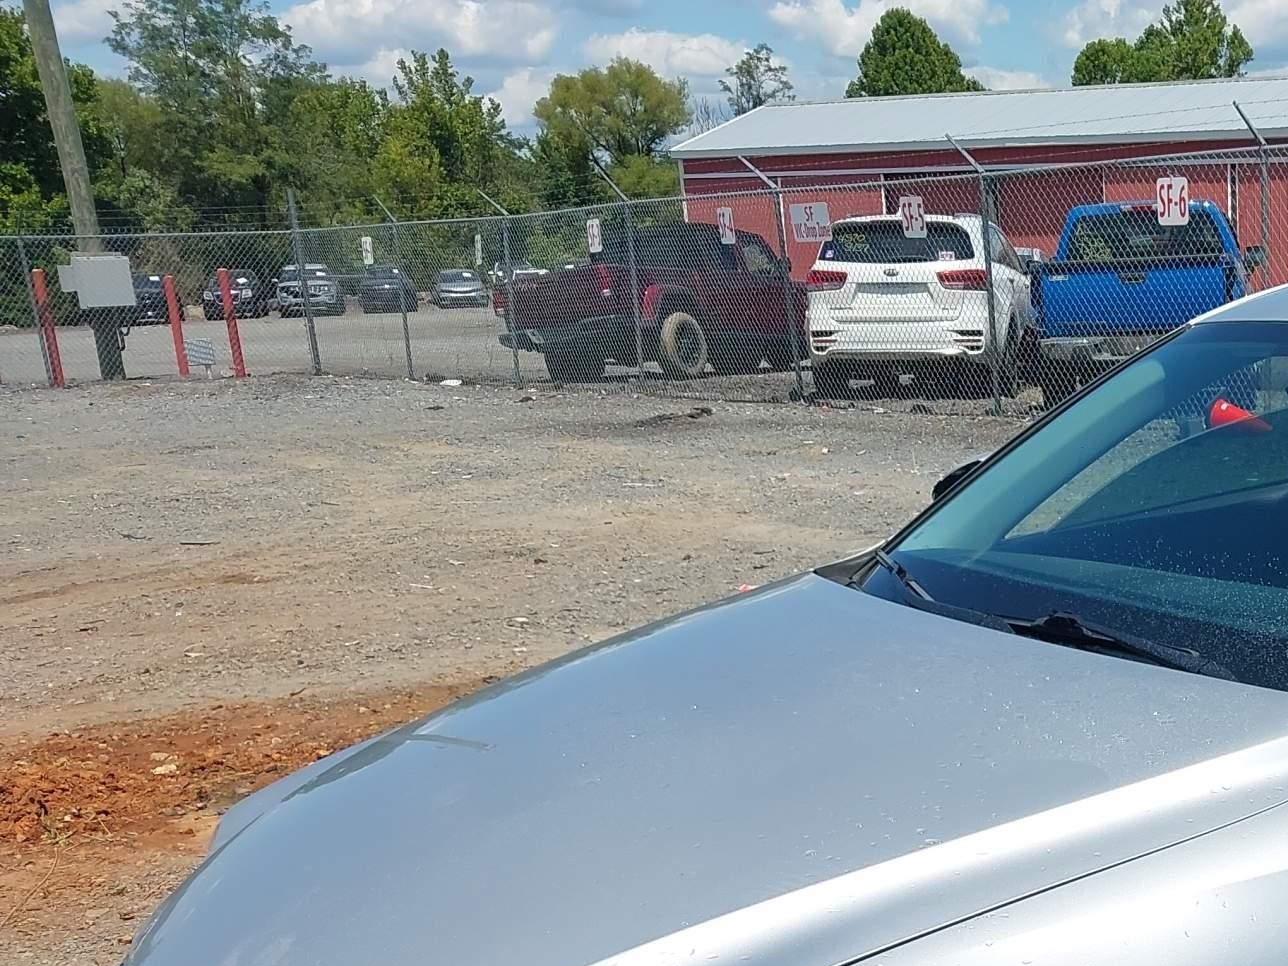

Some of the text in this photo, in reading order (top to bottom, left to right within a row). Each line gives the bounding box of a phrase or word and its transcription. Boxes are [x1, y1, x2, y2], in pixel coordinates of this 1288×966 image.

[804, 205, 814, 222] SF
[1159, 184, 1186, 218] SF-6
[902, 202, 925, 232] SF-5
